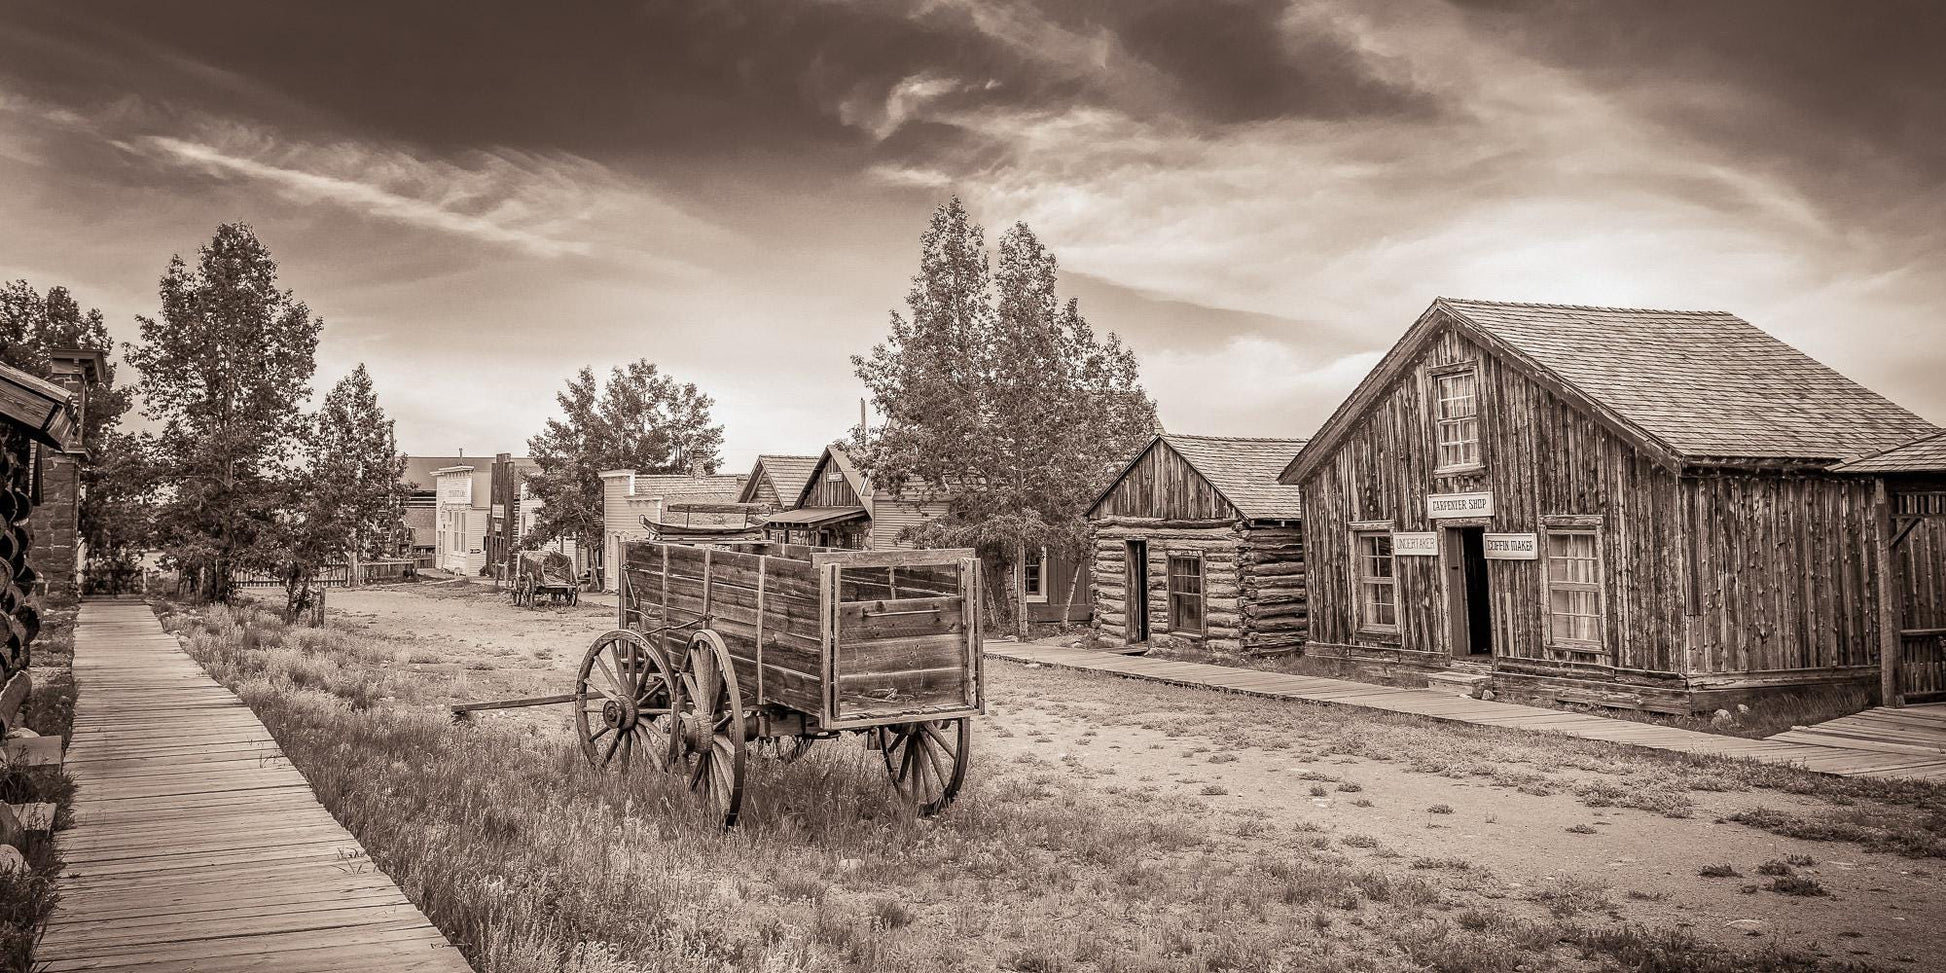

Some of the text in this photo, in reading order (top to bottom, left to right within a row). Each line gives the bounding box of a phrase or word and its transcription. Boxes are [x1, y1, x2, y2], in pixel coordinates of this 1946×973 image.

[1432, 498, 1487, 511] CARPENTER SHOP
[1396, 537, 1435, 550] UNDERTAKER
[1487, 540, 1533, 551] COFFIN MAKER
